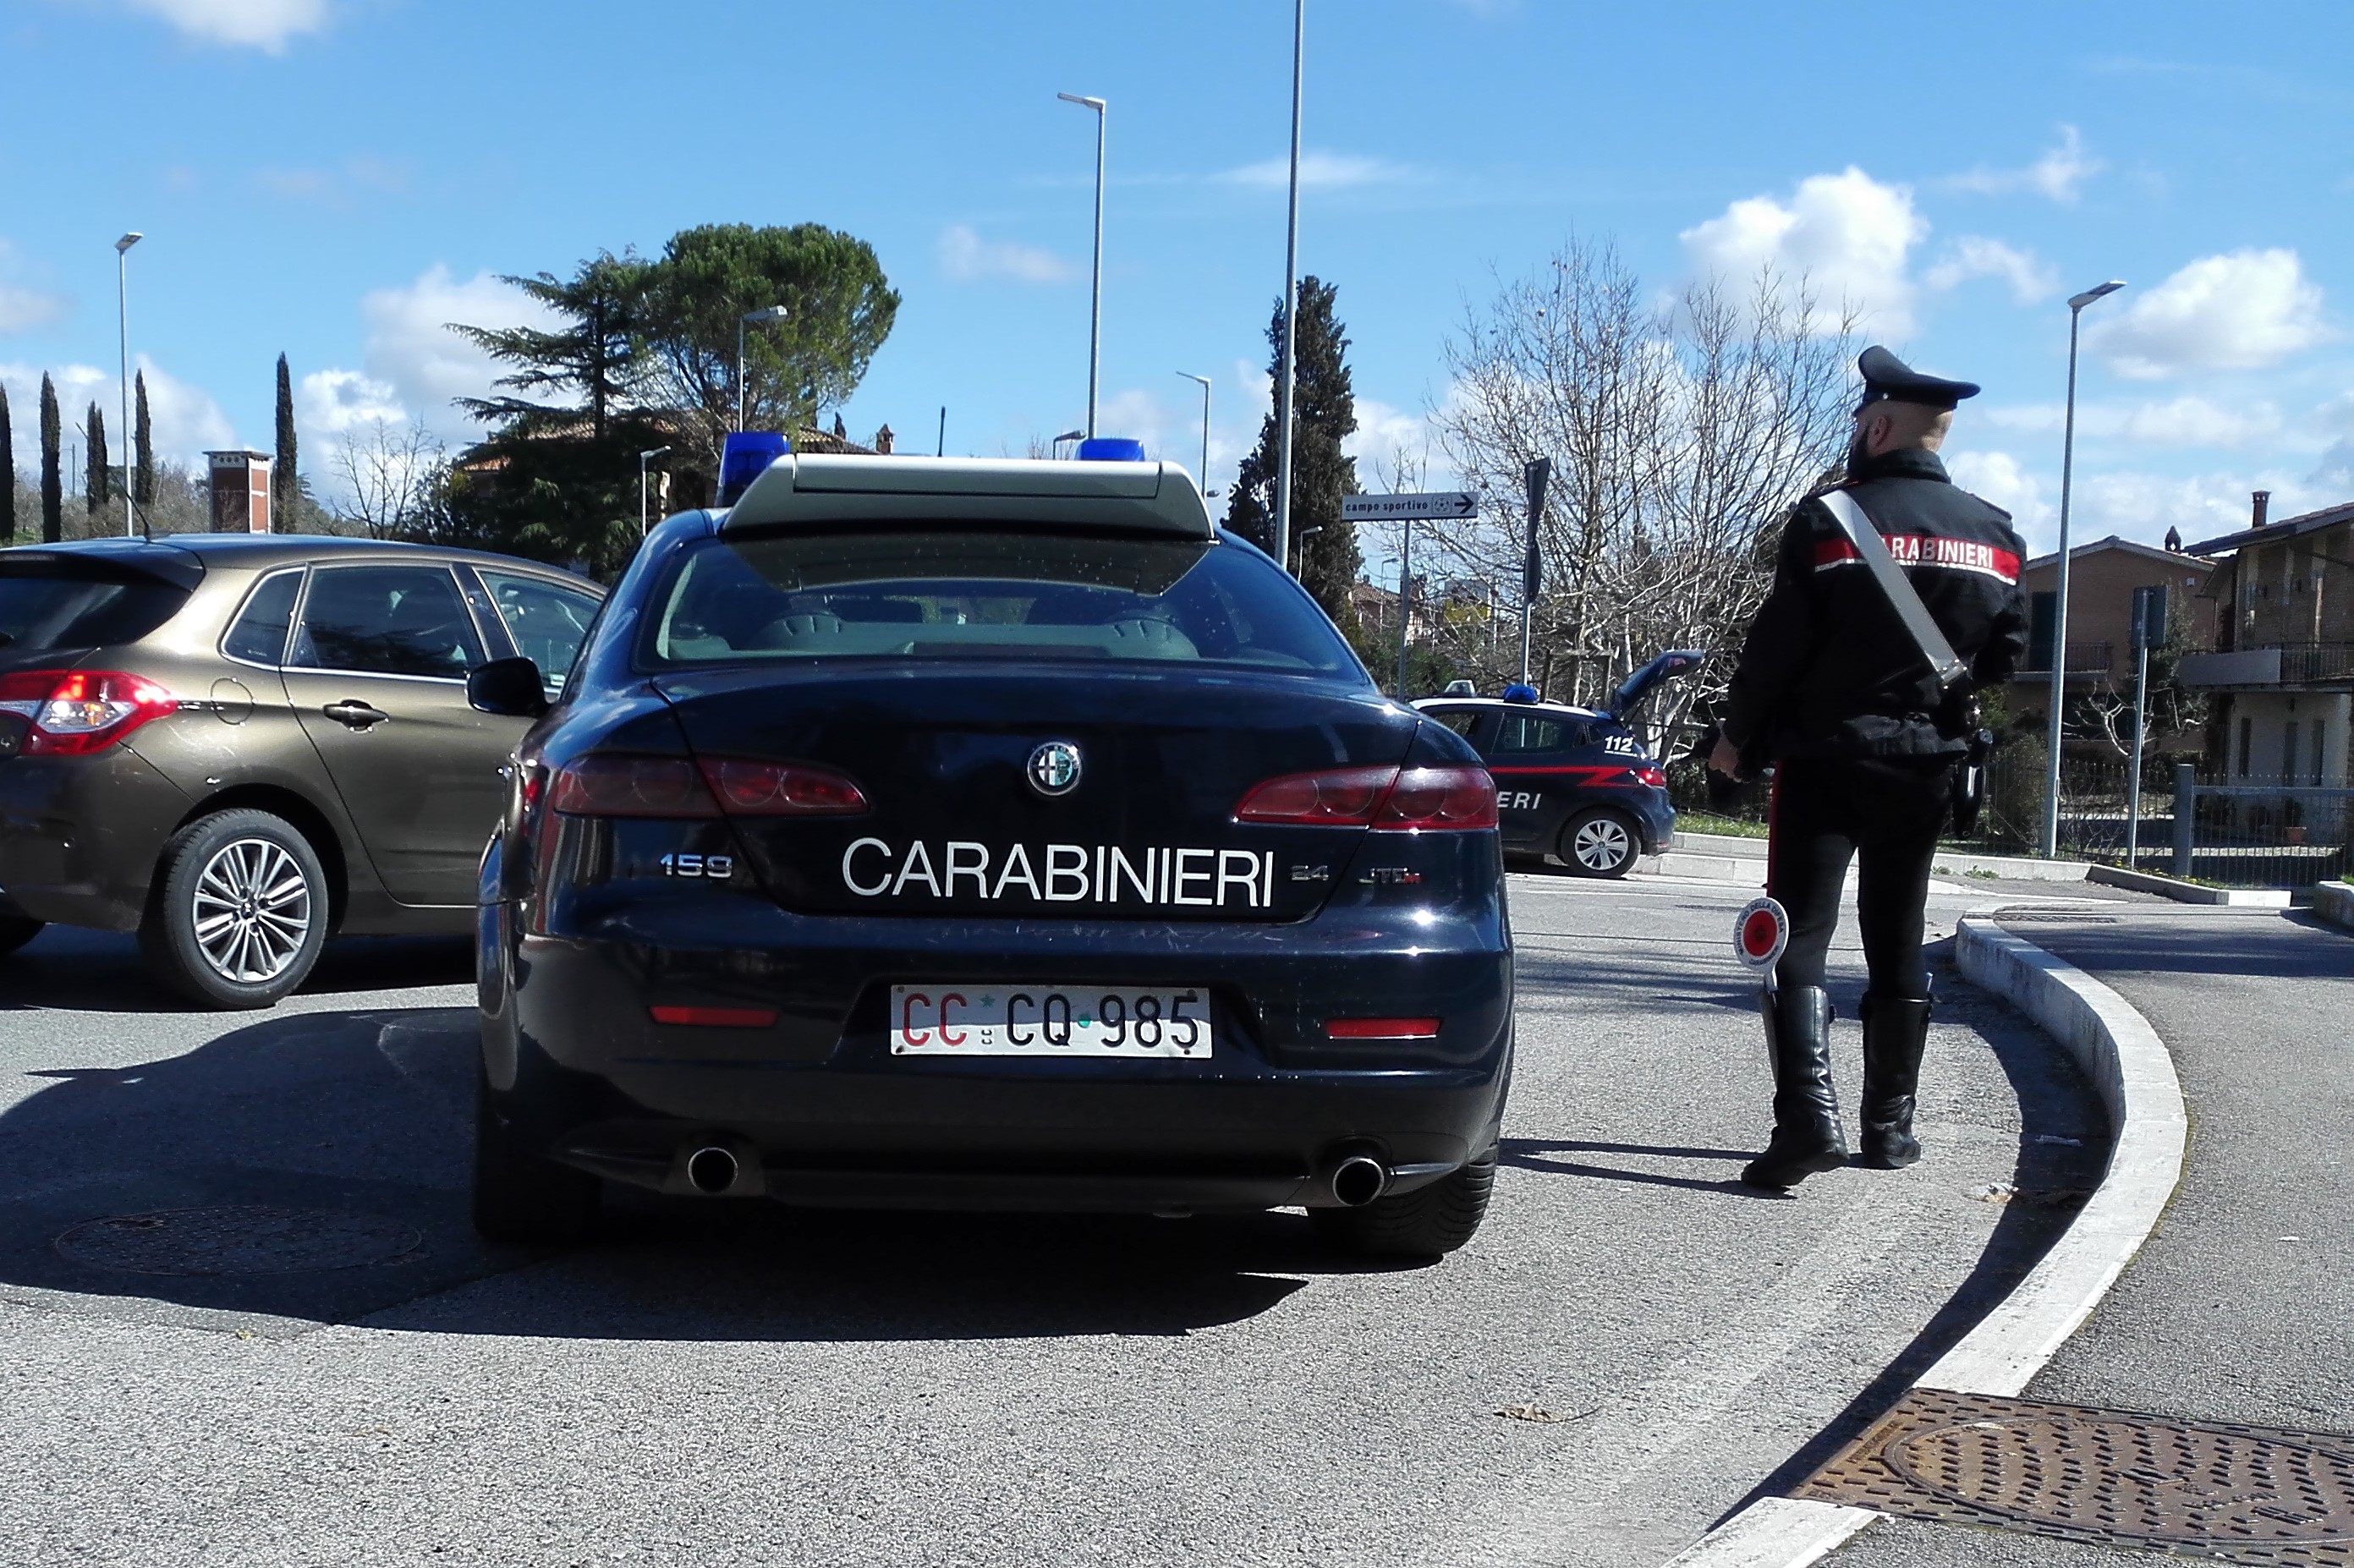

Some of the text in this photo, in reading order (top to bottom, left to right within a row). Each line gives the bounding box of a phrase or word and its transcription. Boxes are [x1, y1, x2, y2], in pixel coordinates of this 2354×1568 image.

[1346, 500, 1429, 513] campo sportivo
[1882, 537, 1994, 569] RABINIERI
[1605, 735, 1634, 753] 112
[661, 853, 733, 878] 159
[842, 836, 1274, 907] CARABINIERI
[903, 993, 1199, 1050] CC CQ 985
